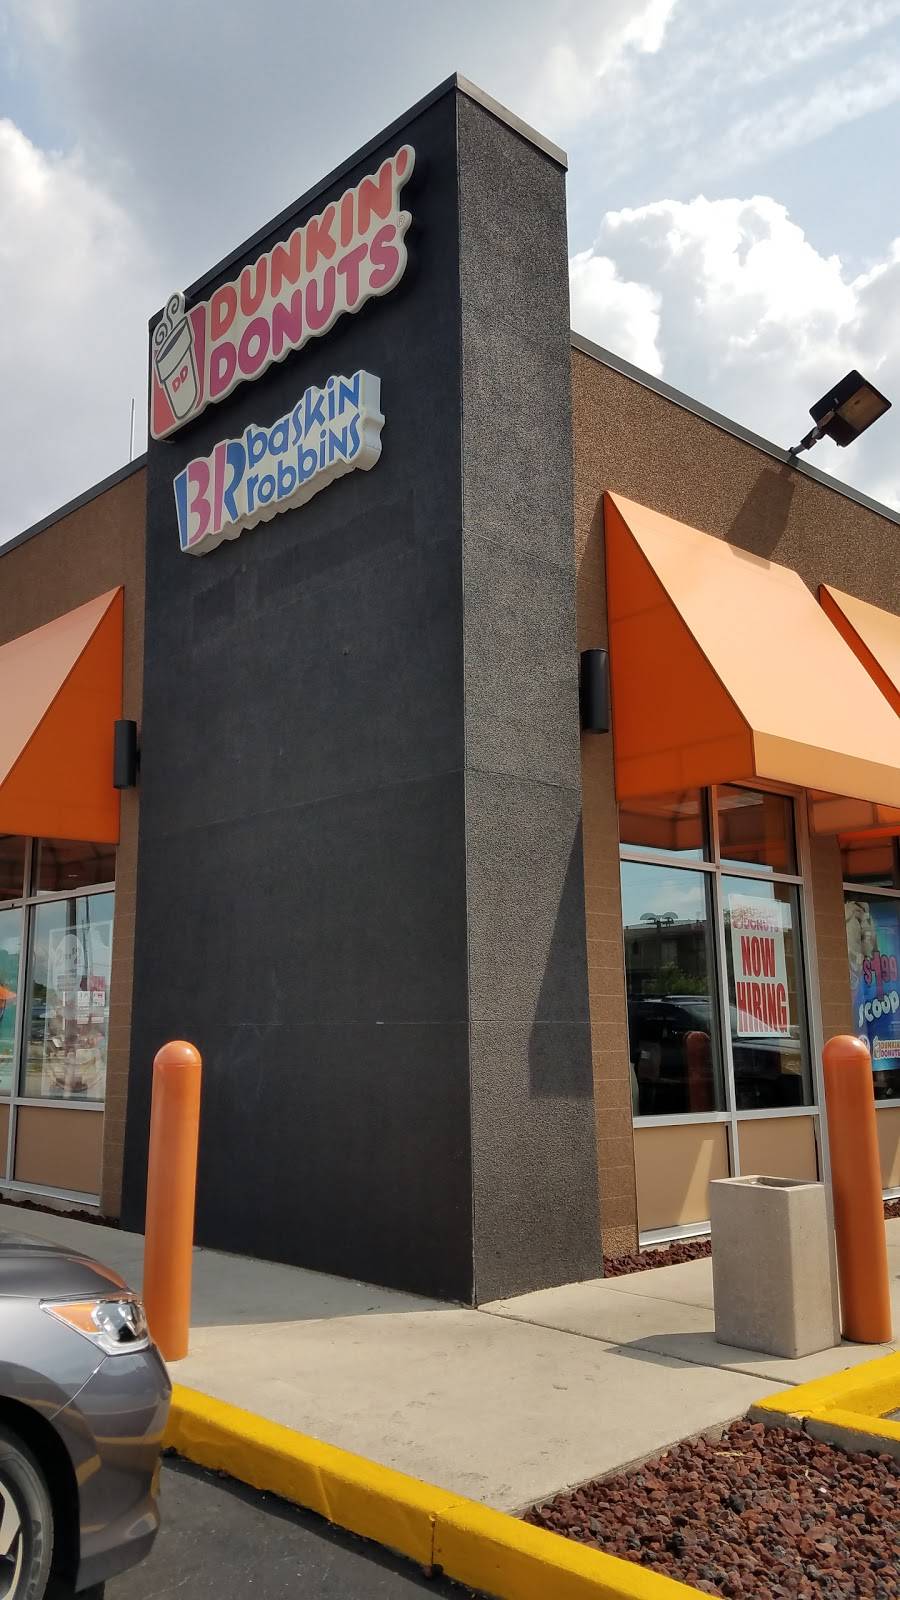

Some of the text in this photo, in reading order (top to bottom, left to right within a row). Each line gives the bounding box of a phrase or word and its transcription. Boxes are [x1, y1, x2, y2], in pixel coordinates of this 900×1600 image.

[211, 149, 408, 342] DUNKIN'
[210, 224, 399, 397] DONUTS
[172, 366, 188, 392] DD
[174, 441, 246, 549] BR
[740, 936, 775, 977] NOW
[737, 982, 787, 1033] HIRING
